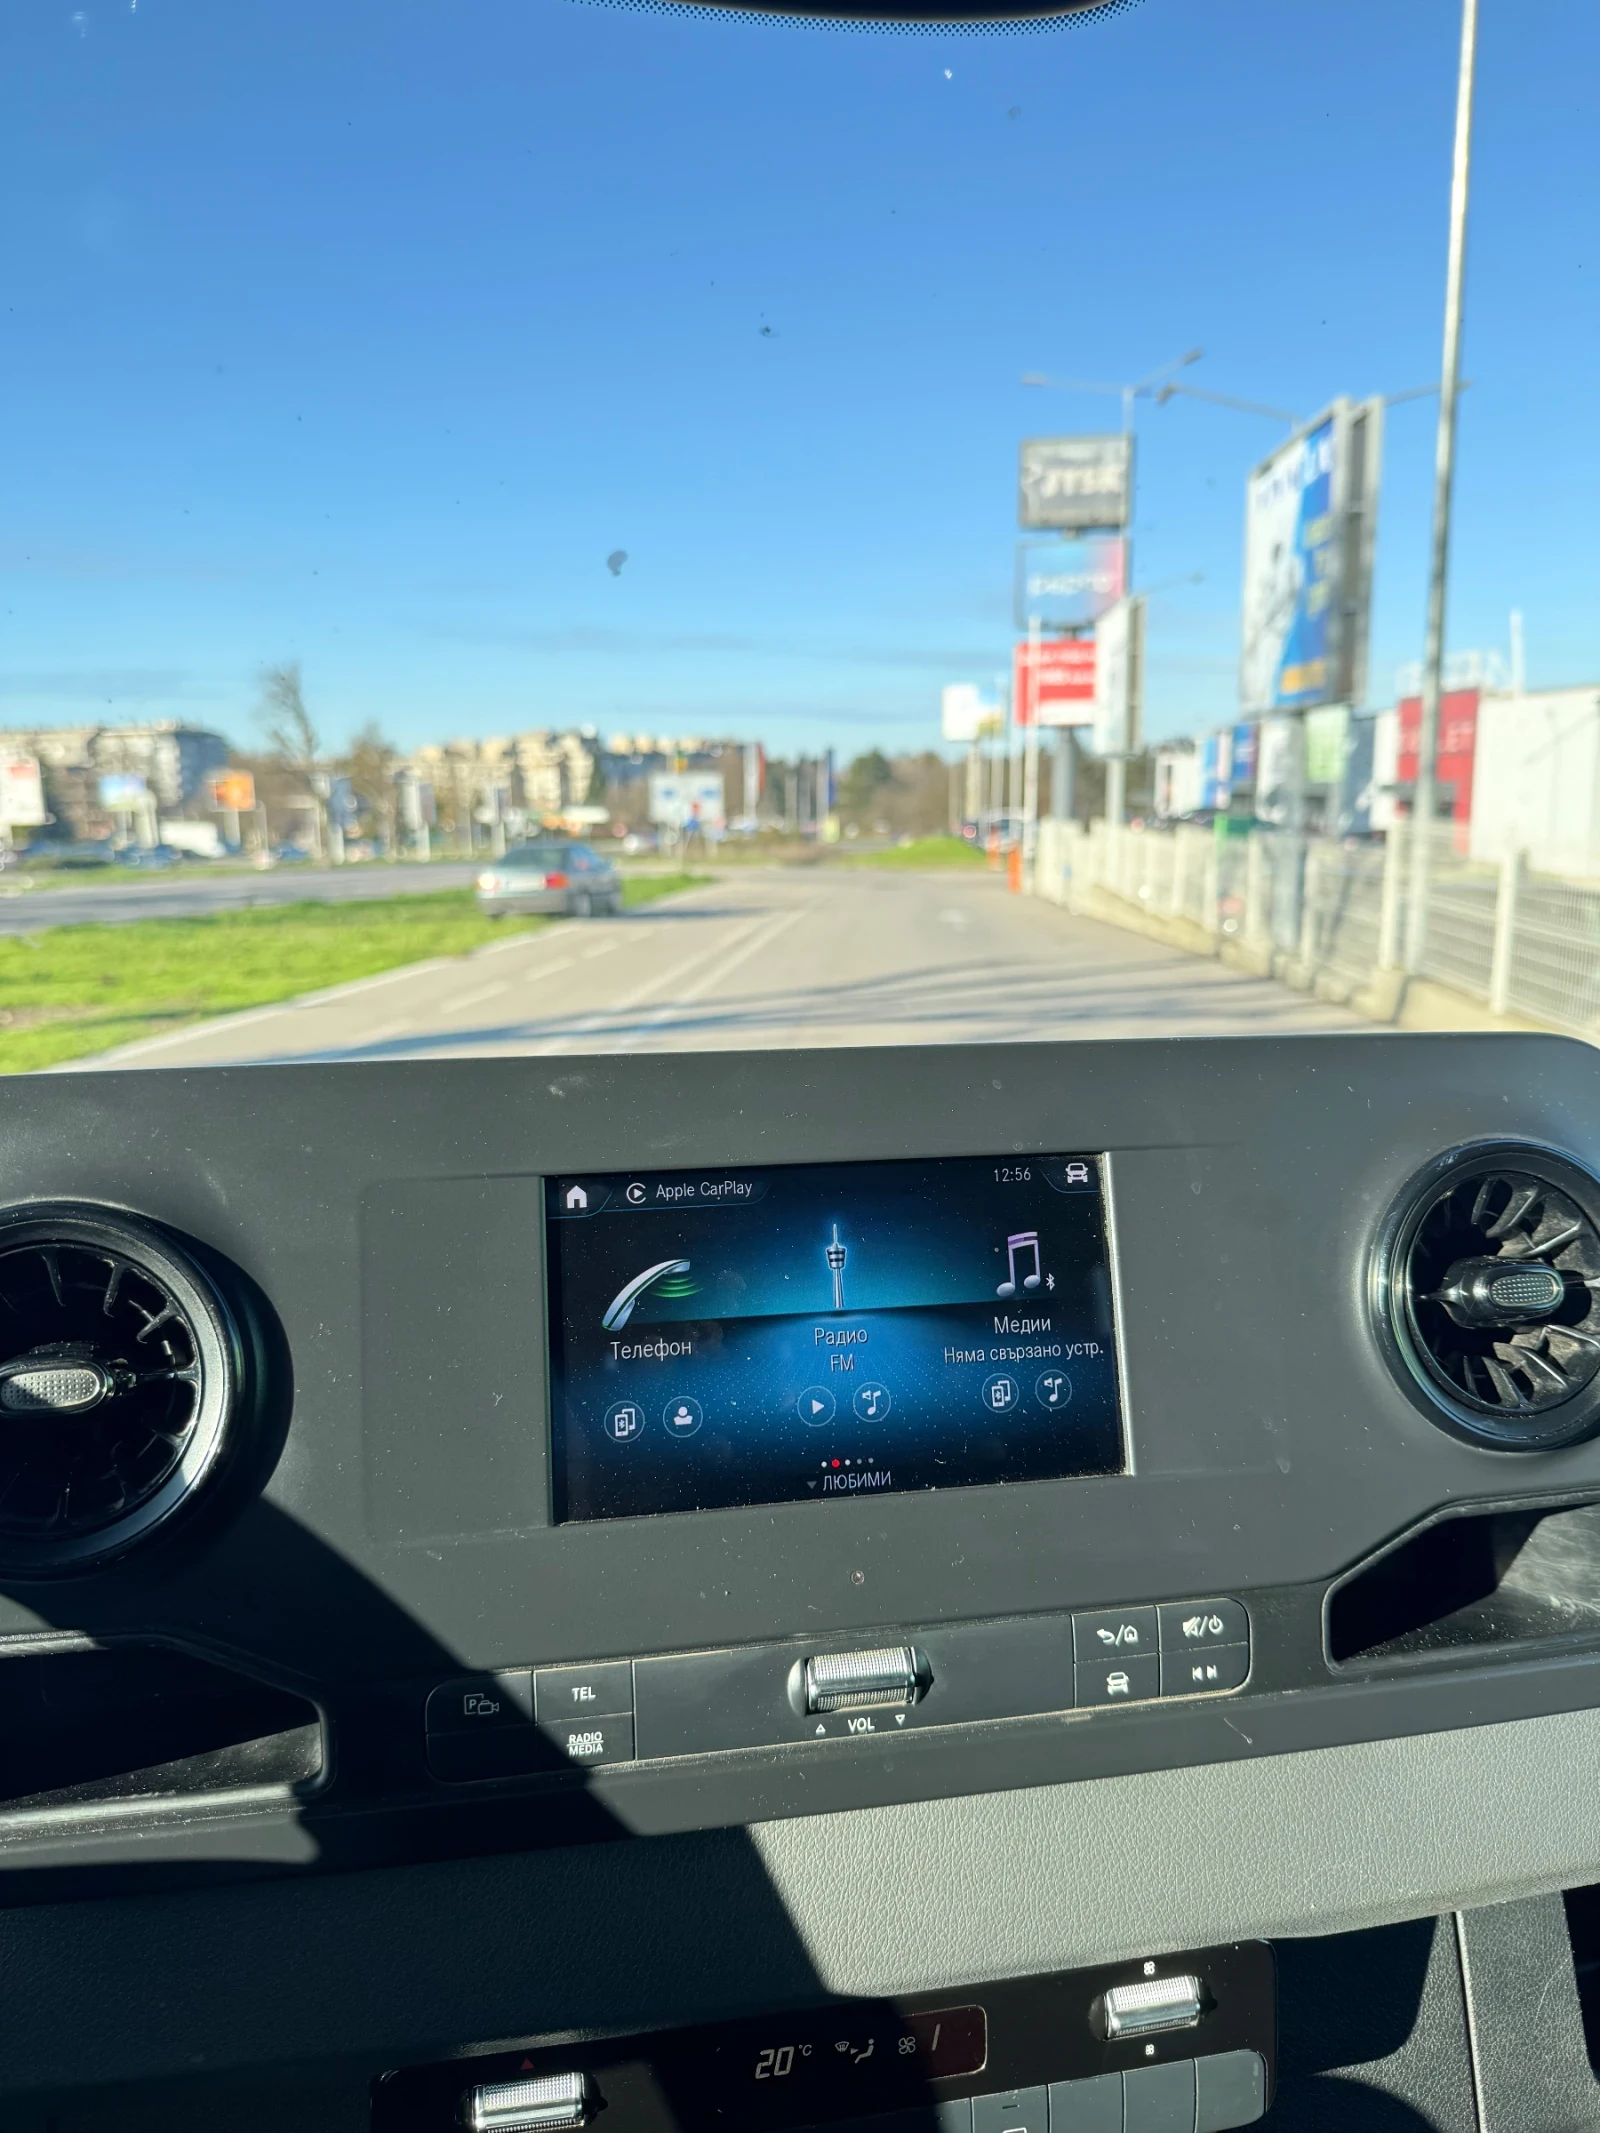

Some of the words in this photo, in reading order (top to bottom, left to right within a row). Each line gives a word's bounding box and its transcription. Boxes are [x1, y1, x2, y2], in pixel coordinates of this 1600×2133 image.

[993, 1167, 1032, 1182] 12:56
[655, 1183, 695, 1201] Apple
[700, 1180, 753, 1197] CarPlay
[993, 1315, 1051, 1335] Медии
[814, 1327, 868, 1347] Радио
[610, 1338, 692, 1361] Телефон
[944, 1347, 985, 1364] Няма
[989, 1344, 1062, 1363] свързано
[1065, 1342, 1104, 1360] устр.
[830, 1354, 855, 1373] FM
[822, 1471, 892, 1491] ЛЮБИМИ
[571, 1686, 597, 1702] TEL
[848, 1717, 875, 1734] VOL
[568, 1731, 603, 1744] RADIO
[568, 1743, 604, 1757] MEDIA
